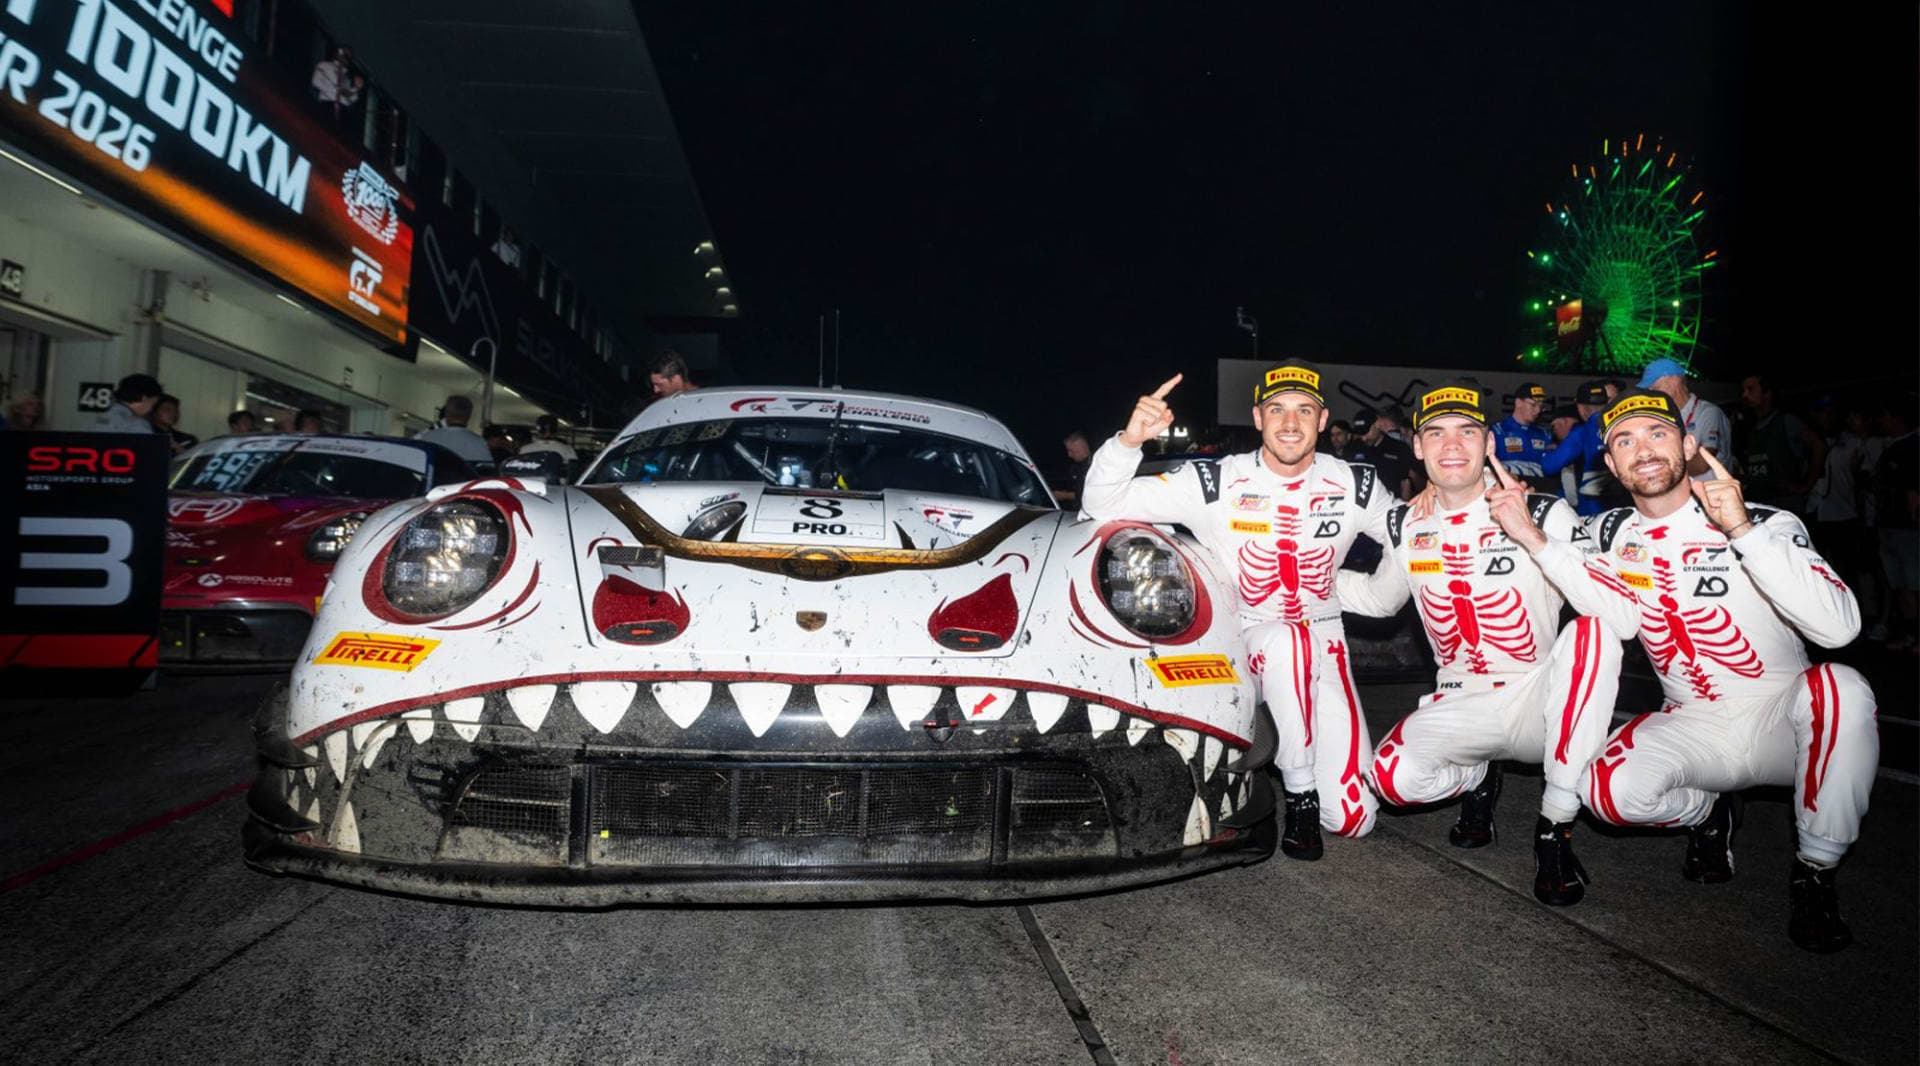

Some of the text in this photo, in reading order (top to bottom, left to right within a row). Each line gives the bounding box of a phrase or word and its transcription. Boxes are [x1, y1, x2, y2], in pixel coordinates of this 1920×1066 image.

[66, 0, 312, 215] 1000KM
[38, 69, 157, 173] 2026
[1, 266, 22, 293] 48
[79, 387, 112, 409] 48
[27, 447, 135, 473] SRO
[26, 475, 97, 483] MOTORSPORTS
[26, 483, 50, 491] ASIA
[1359, 467, 1372, 500] HRX
[800, 498, 844, 520] 8
[793, 522, 847, 536] PRO
[14, 517, 134, 606] 3
[225, 575, 294, 584] ABSOLUTE
[326, 638, 425, 665] PIRELLI
[1157, 660, 1233, 682] PIRELLI
[1440, 681, 1463, 689] HRX
